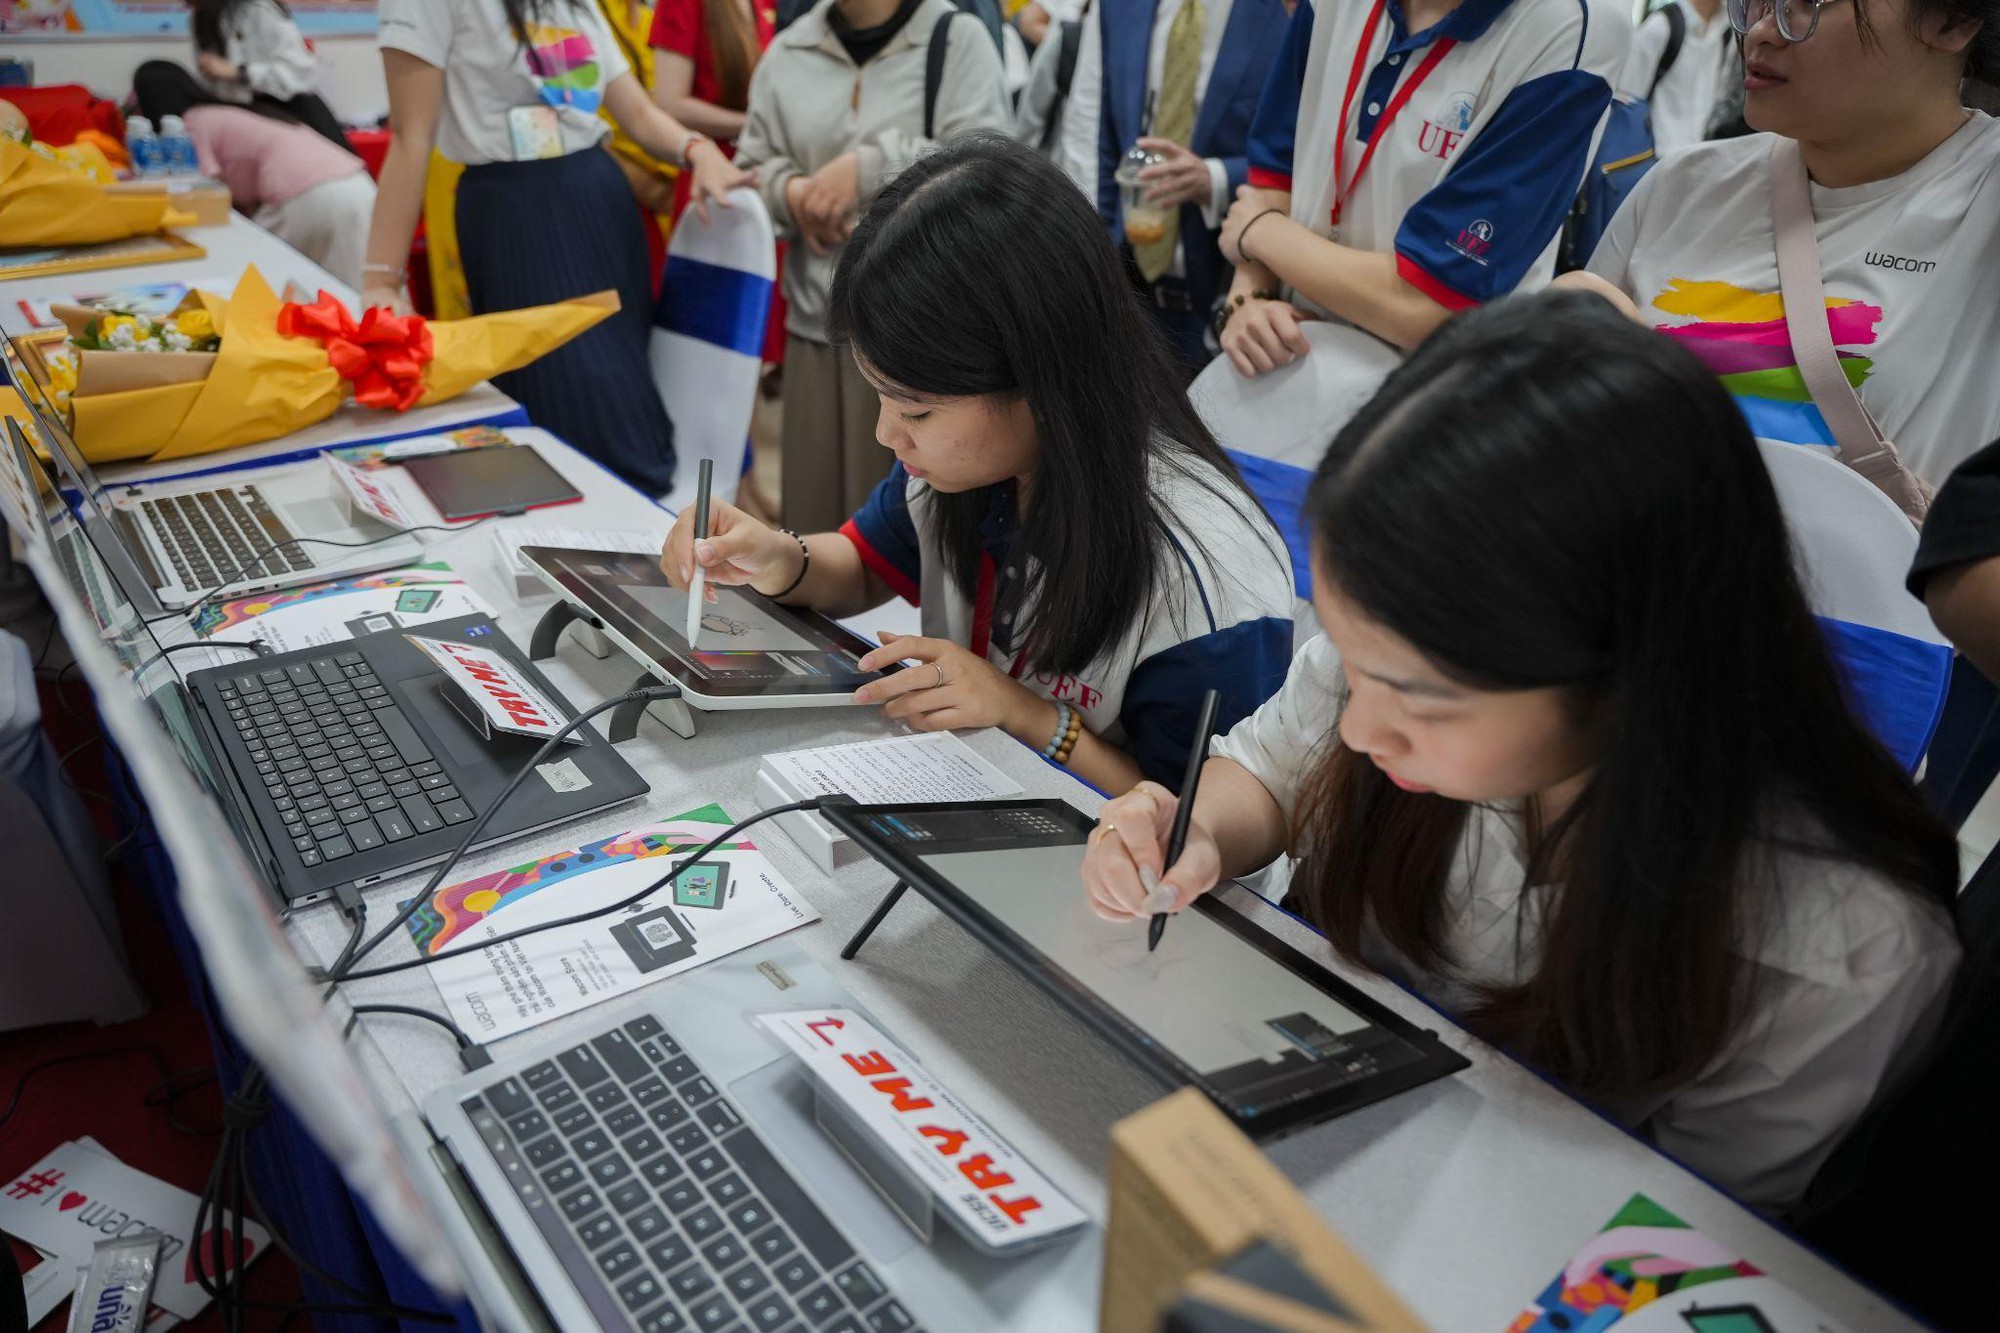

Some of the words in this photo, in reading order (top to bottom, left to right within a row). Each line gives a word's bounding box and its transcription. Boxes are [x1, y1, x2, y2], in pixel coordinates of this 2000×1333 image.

[1865, 251, 1936, 273] wacom
[453, 655, 508, 686] ME
[482, 684, 549, 727] TRY
[465, 992, 496, 1030] wacom
[841, 1050, 935, 1112] ME
[917, 1124, 1042, 1225] TRY
